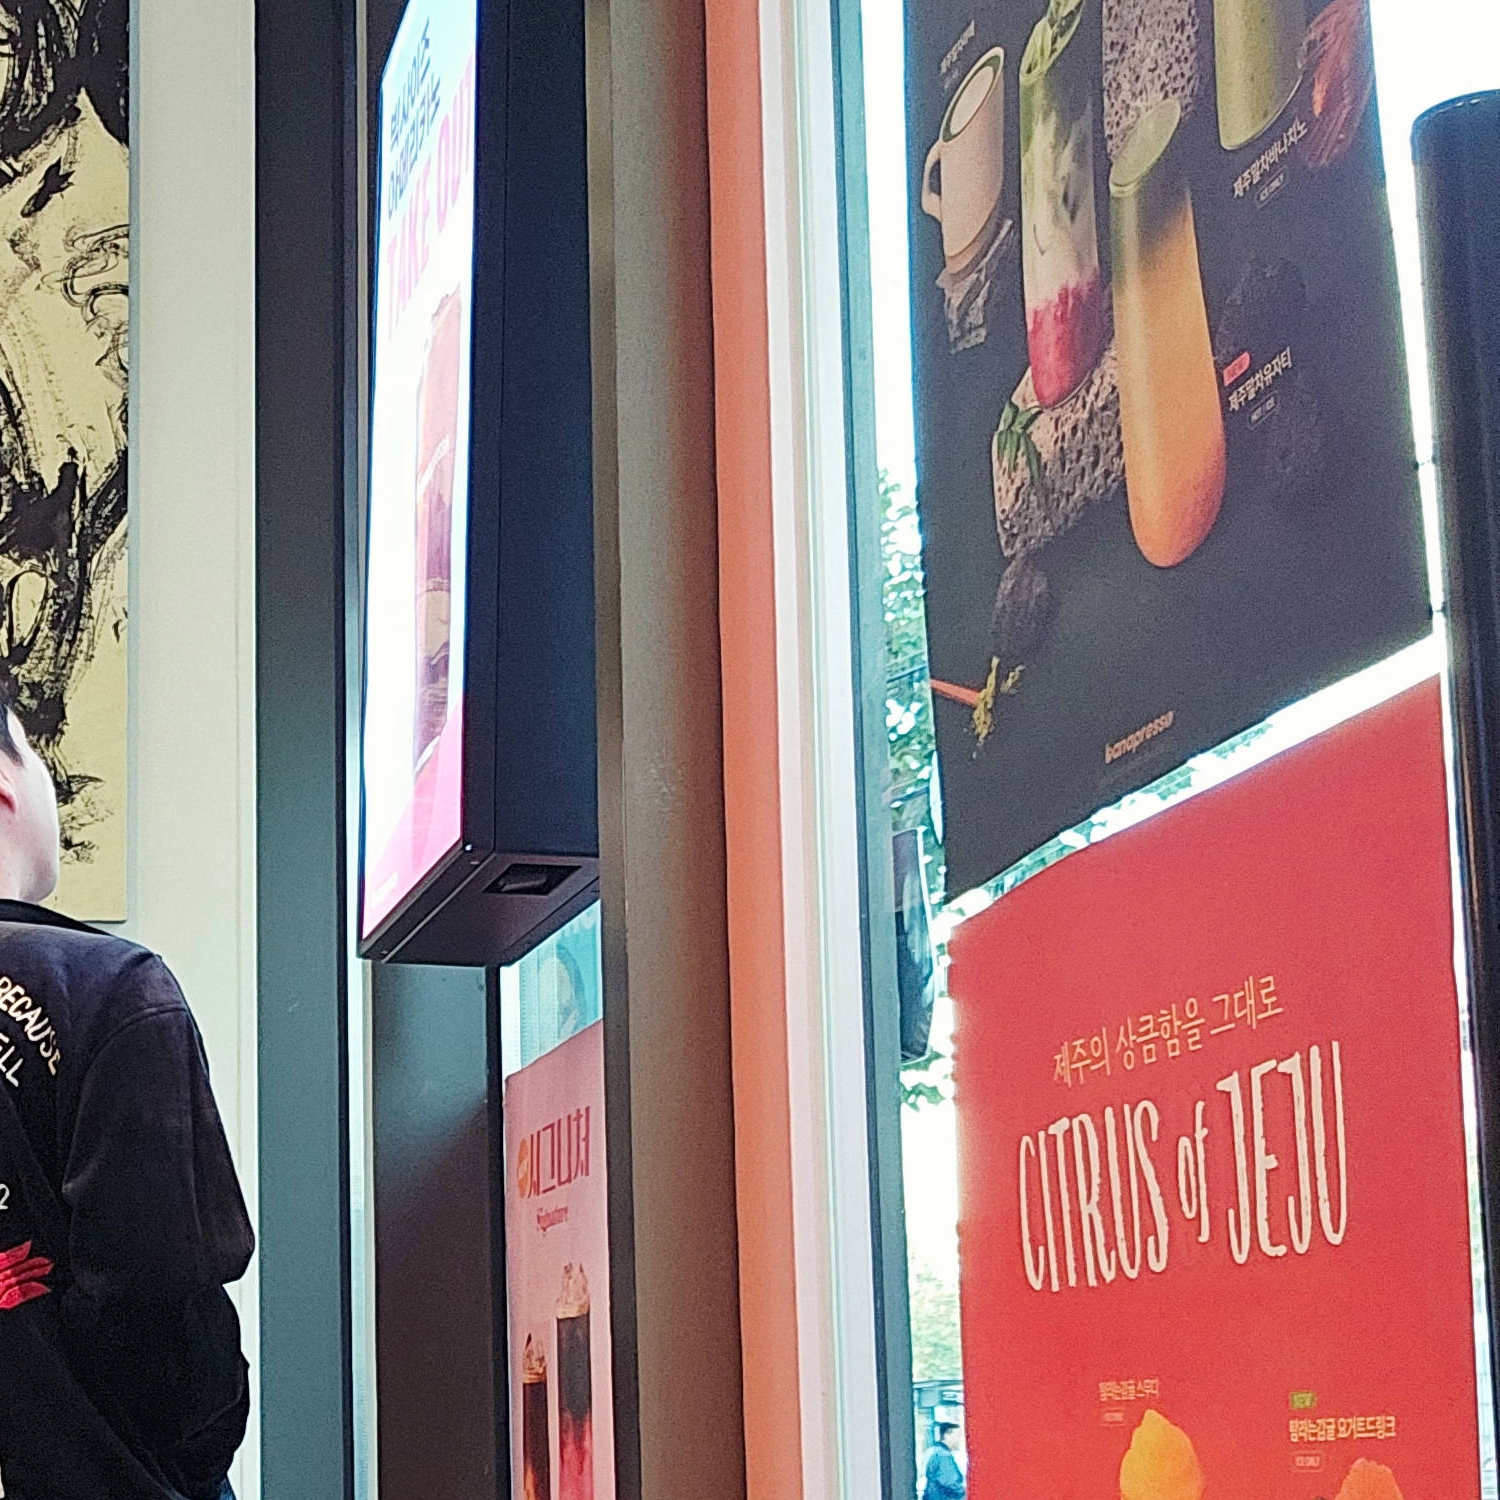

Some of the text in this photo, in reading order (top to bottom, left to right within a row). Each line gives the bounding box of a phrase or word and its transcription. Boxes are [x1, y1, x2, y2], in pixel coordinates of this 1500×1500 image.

[387, 50, 473, 342] TAKE OUT
[1105, 710, 1174, 764] banapresso
[1053, 975, 1285, 1088] 제주의 상큼함을 그대로
[1019, 1040, 1348, 1292] CITRUS of JEJU
[1337, 1416, 1396, 1439] 요거트드링크
